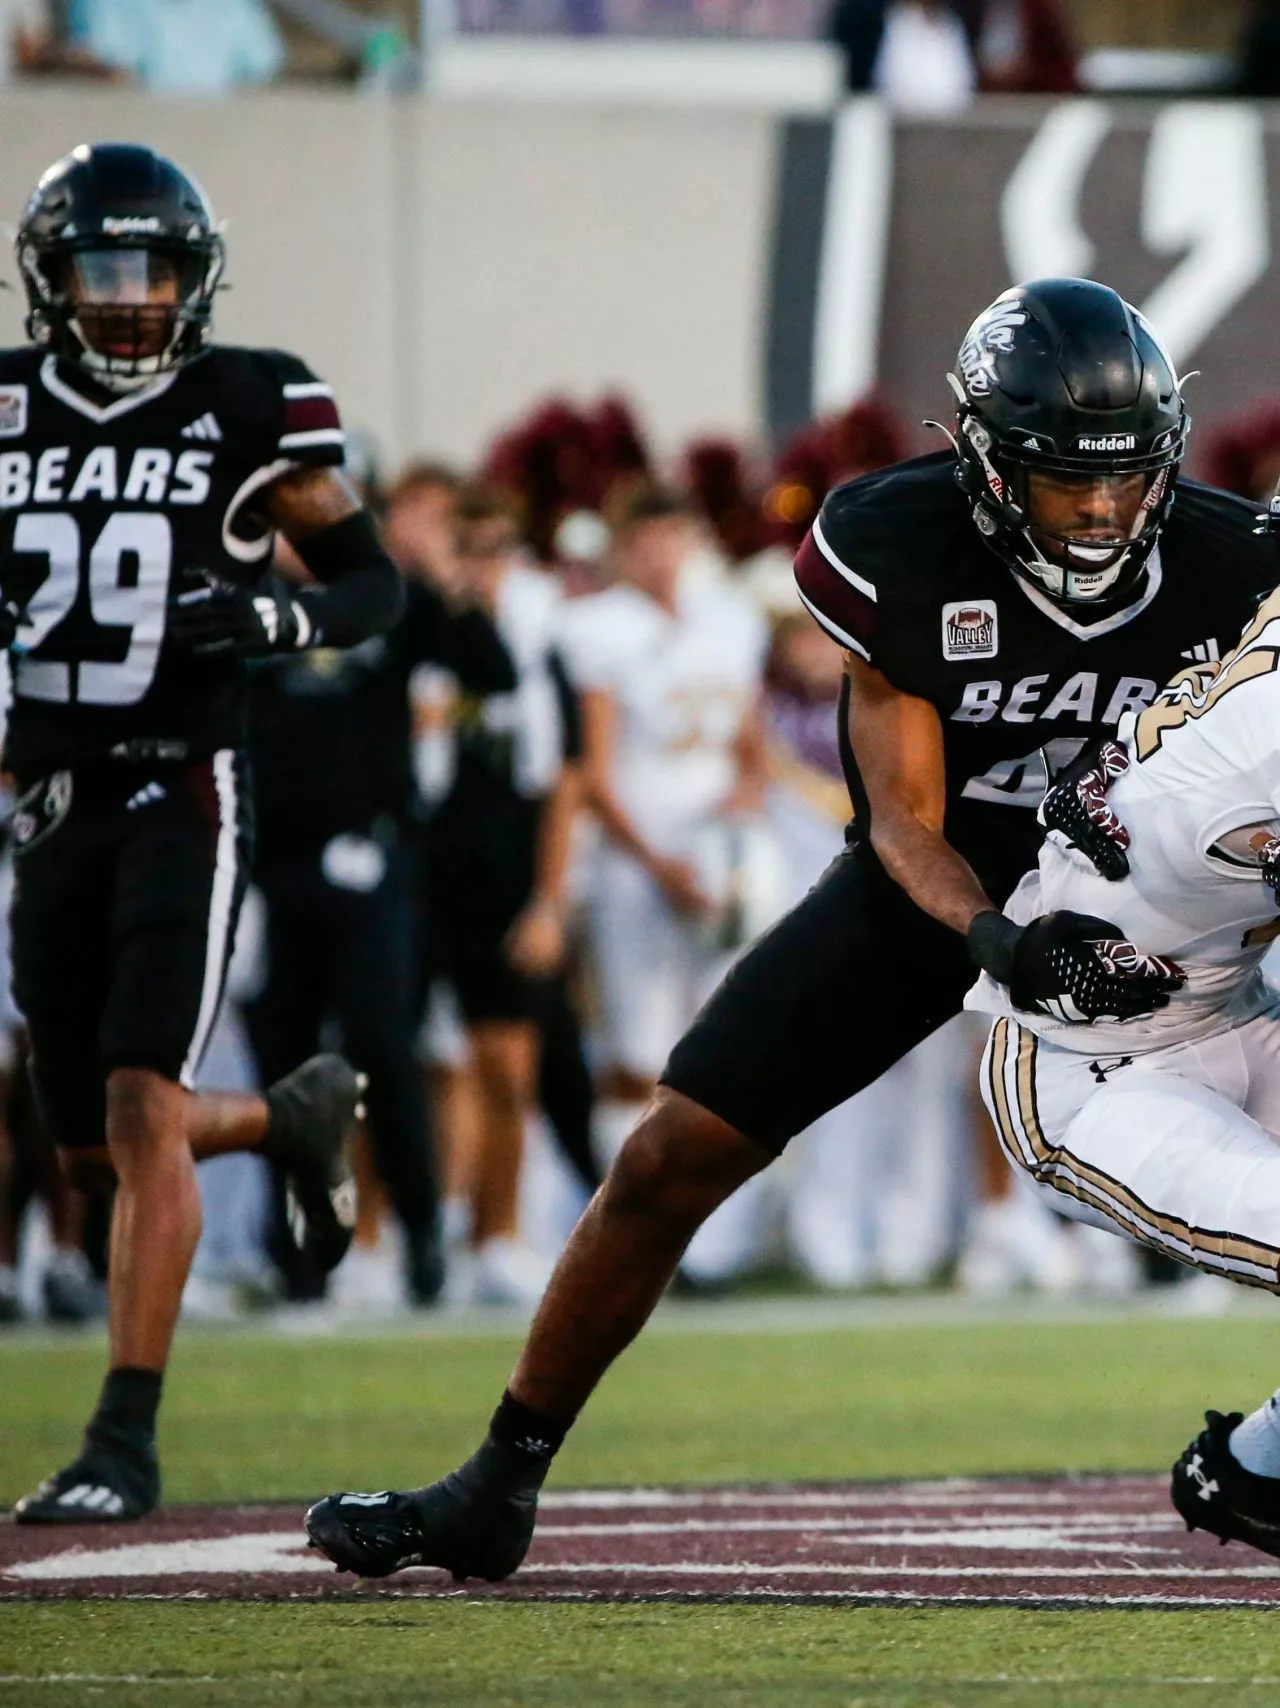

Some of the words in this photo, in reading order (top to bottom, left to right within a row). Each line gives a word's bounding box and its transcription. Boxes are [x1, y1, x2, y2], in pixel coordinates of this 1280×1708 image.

[1078, 435, 1135, 451] Riddell
[0, 446, 215, 509] BEARS
[1074, 575, 1103, 584] Riddell
[13, 512, 173, 706] 29
[947, 620, 993, 646] VALLEY
[950, 671, 1158, 725] BEAR
